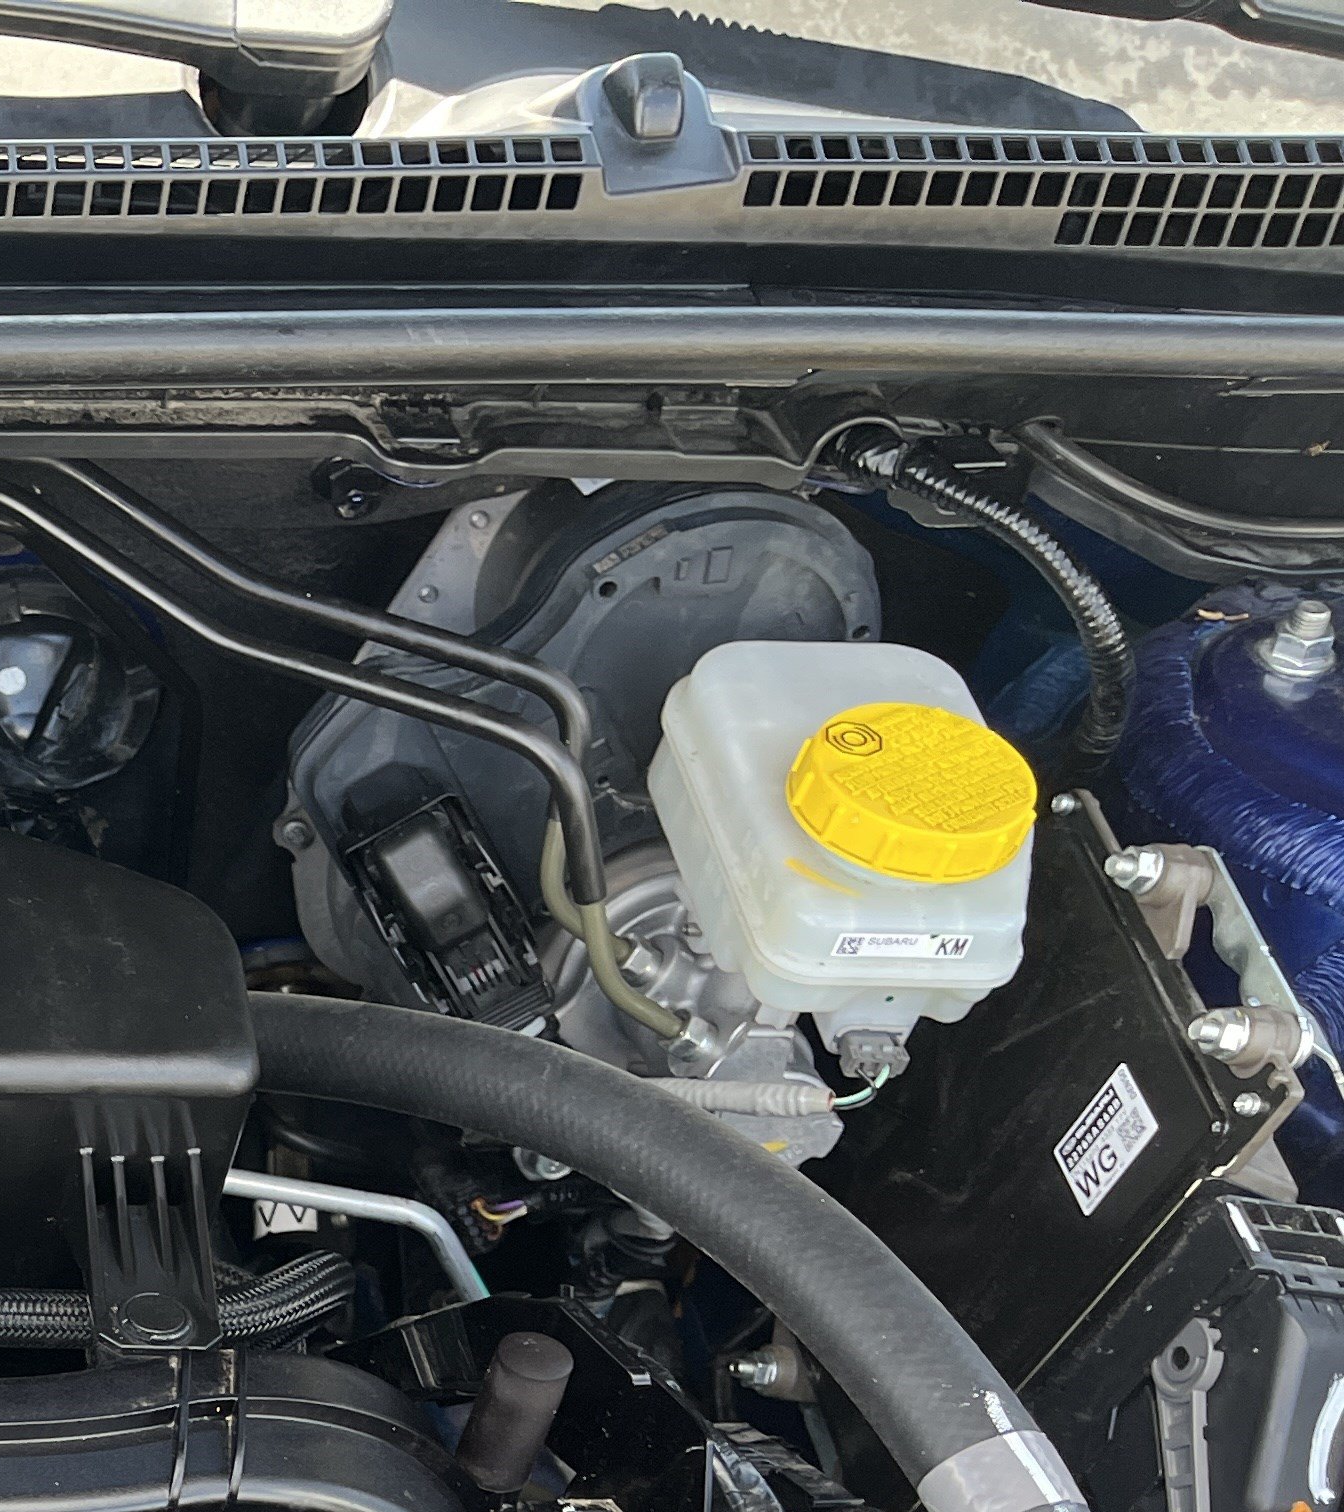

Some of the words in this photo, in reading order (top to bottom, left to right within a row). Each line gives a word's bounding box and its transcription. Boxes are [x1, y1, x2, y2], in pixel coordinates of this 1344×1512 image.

[867, 936, 919, 946] SUBARU
[934, 937, 969, 956] KM
[1075, 1143, 1118, 1199] WG
